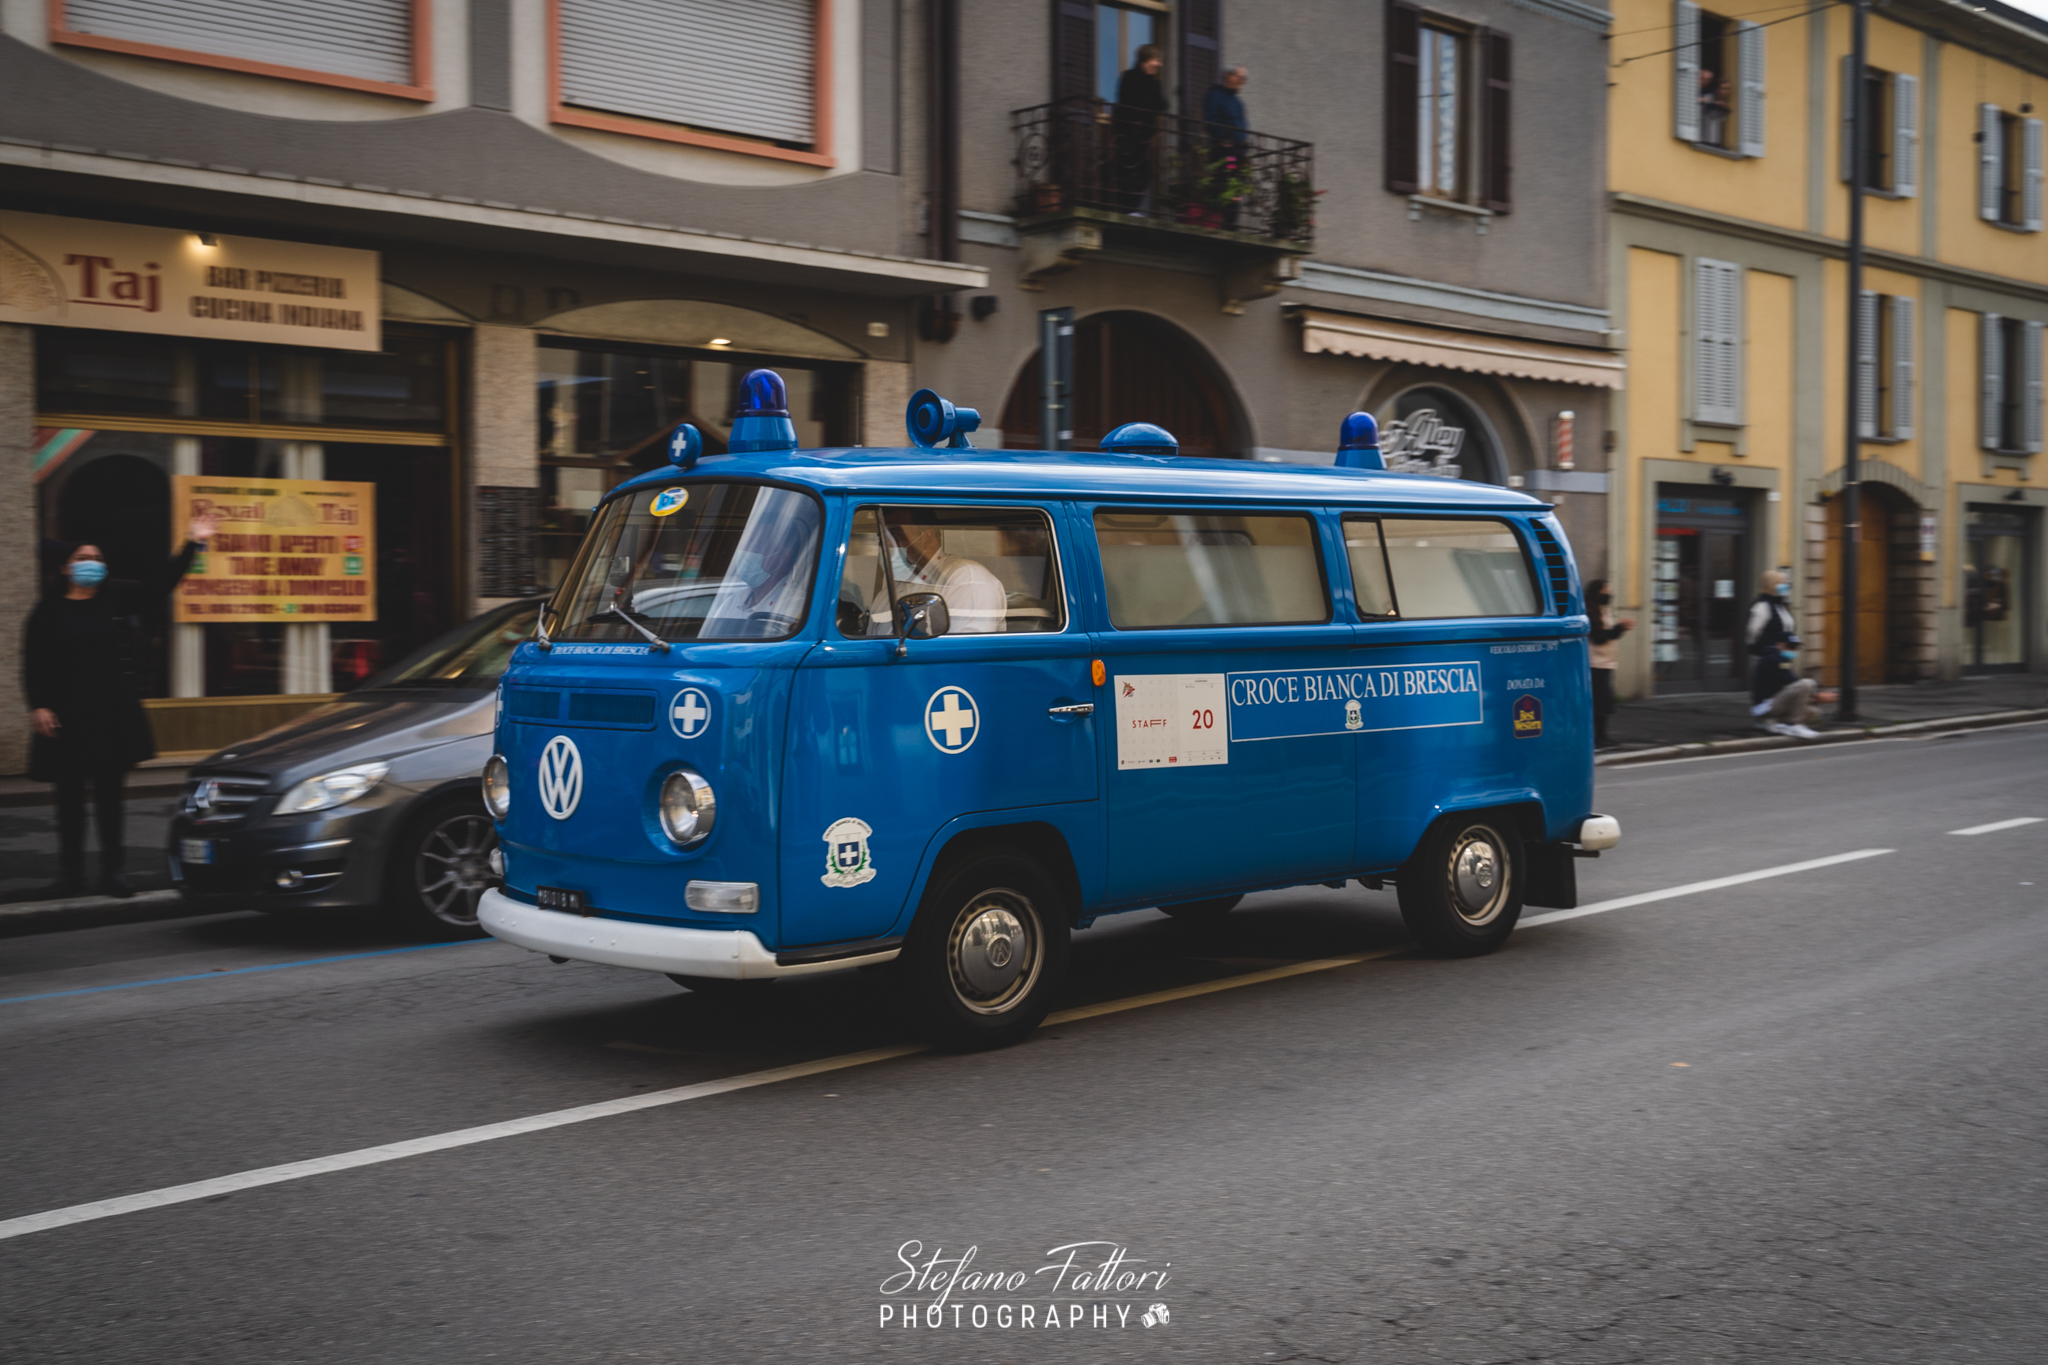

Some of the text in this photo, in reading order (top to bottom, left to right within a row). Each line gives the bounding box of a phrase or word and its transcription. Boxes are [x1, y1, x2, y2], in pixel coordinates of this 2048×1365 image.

[65, 253, 162, 313] Taj
[255, 270, 345, 299] PIZZERIA
[278, 303, 365, 332] INDIANA
[318, 503, 358, 525] Taj
[550, 646, 574, 655] CROCE
[573, 645, 602, 654] BIANCA
[612, 645, 649, 655] BRESCIA
[1231, 668, 1478, 706] CROCE BIANCA DI BRESCIA
[1132, 719, 1167, 728] STAFF
[1192, 709, 1214, 729] 20
